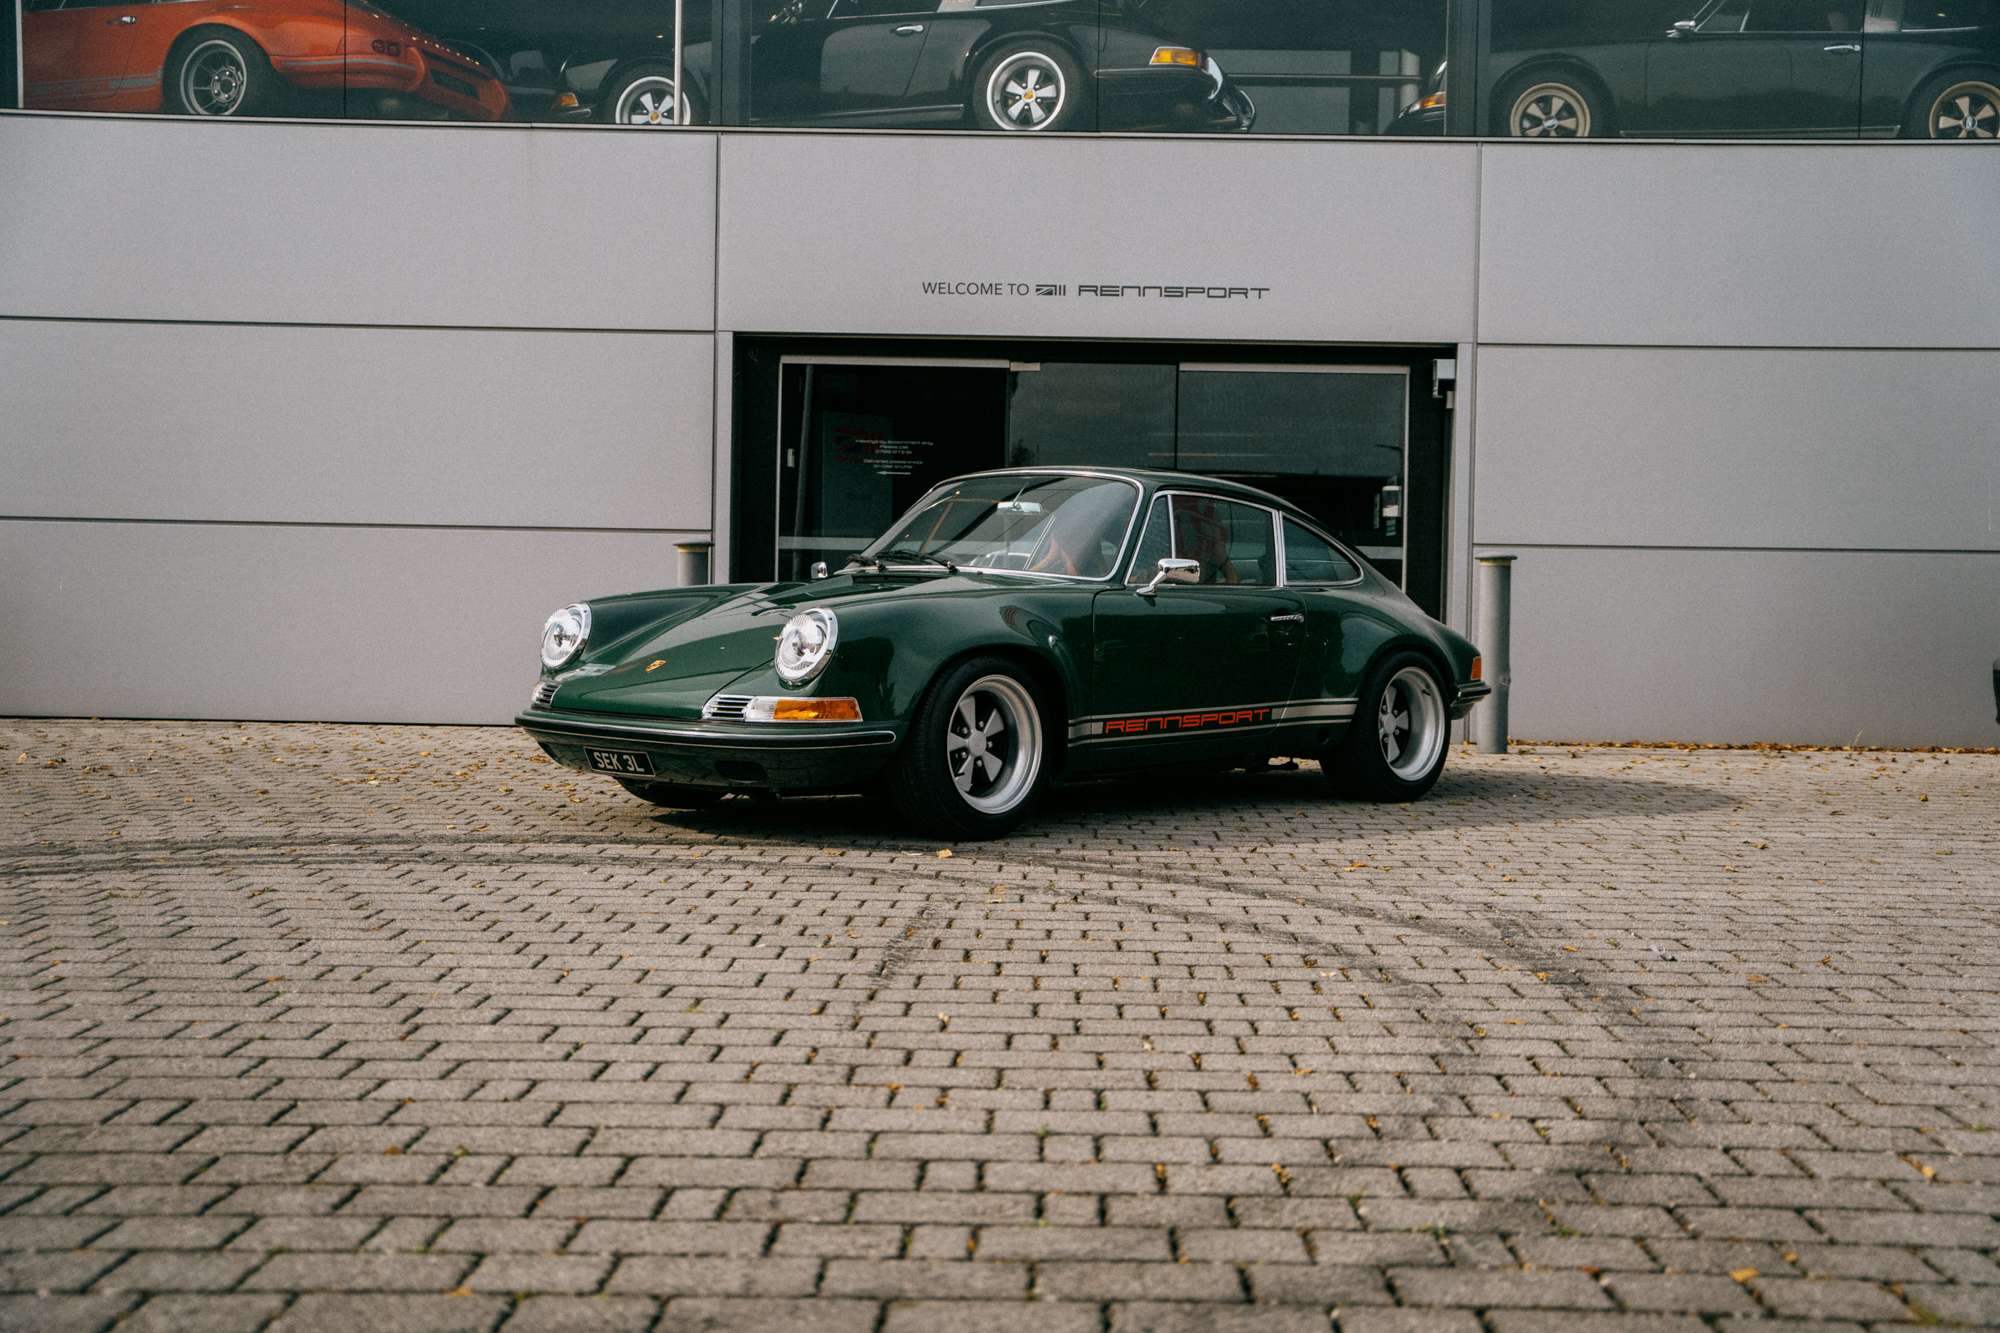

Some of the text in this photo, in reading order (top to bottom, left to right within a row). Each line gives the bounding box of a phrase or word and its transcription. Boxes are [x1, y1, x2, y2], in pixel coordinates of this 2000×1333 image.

[921, 281, 1271, 300] WELCOME TO RENNSPORT
[1105, 708, 1270, 735] RENNSPORT
[593, 751, 645, 773] SEK 3L
